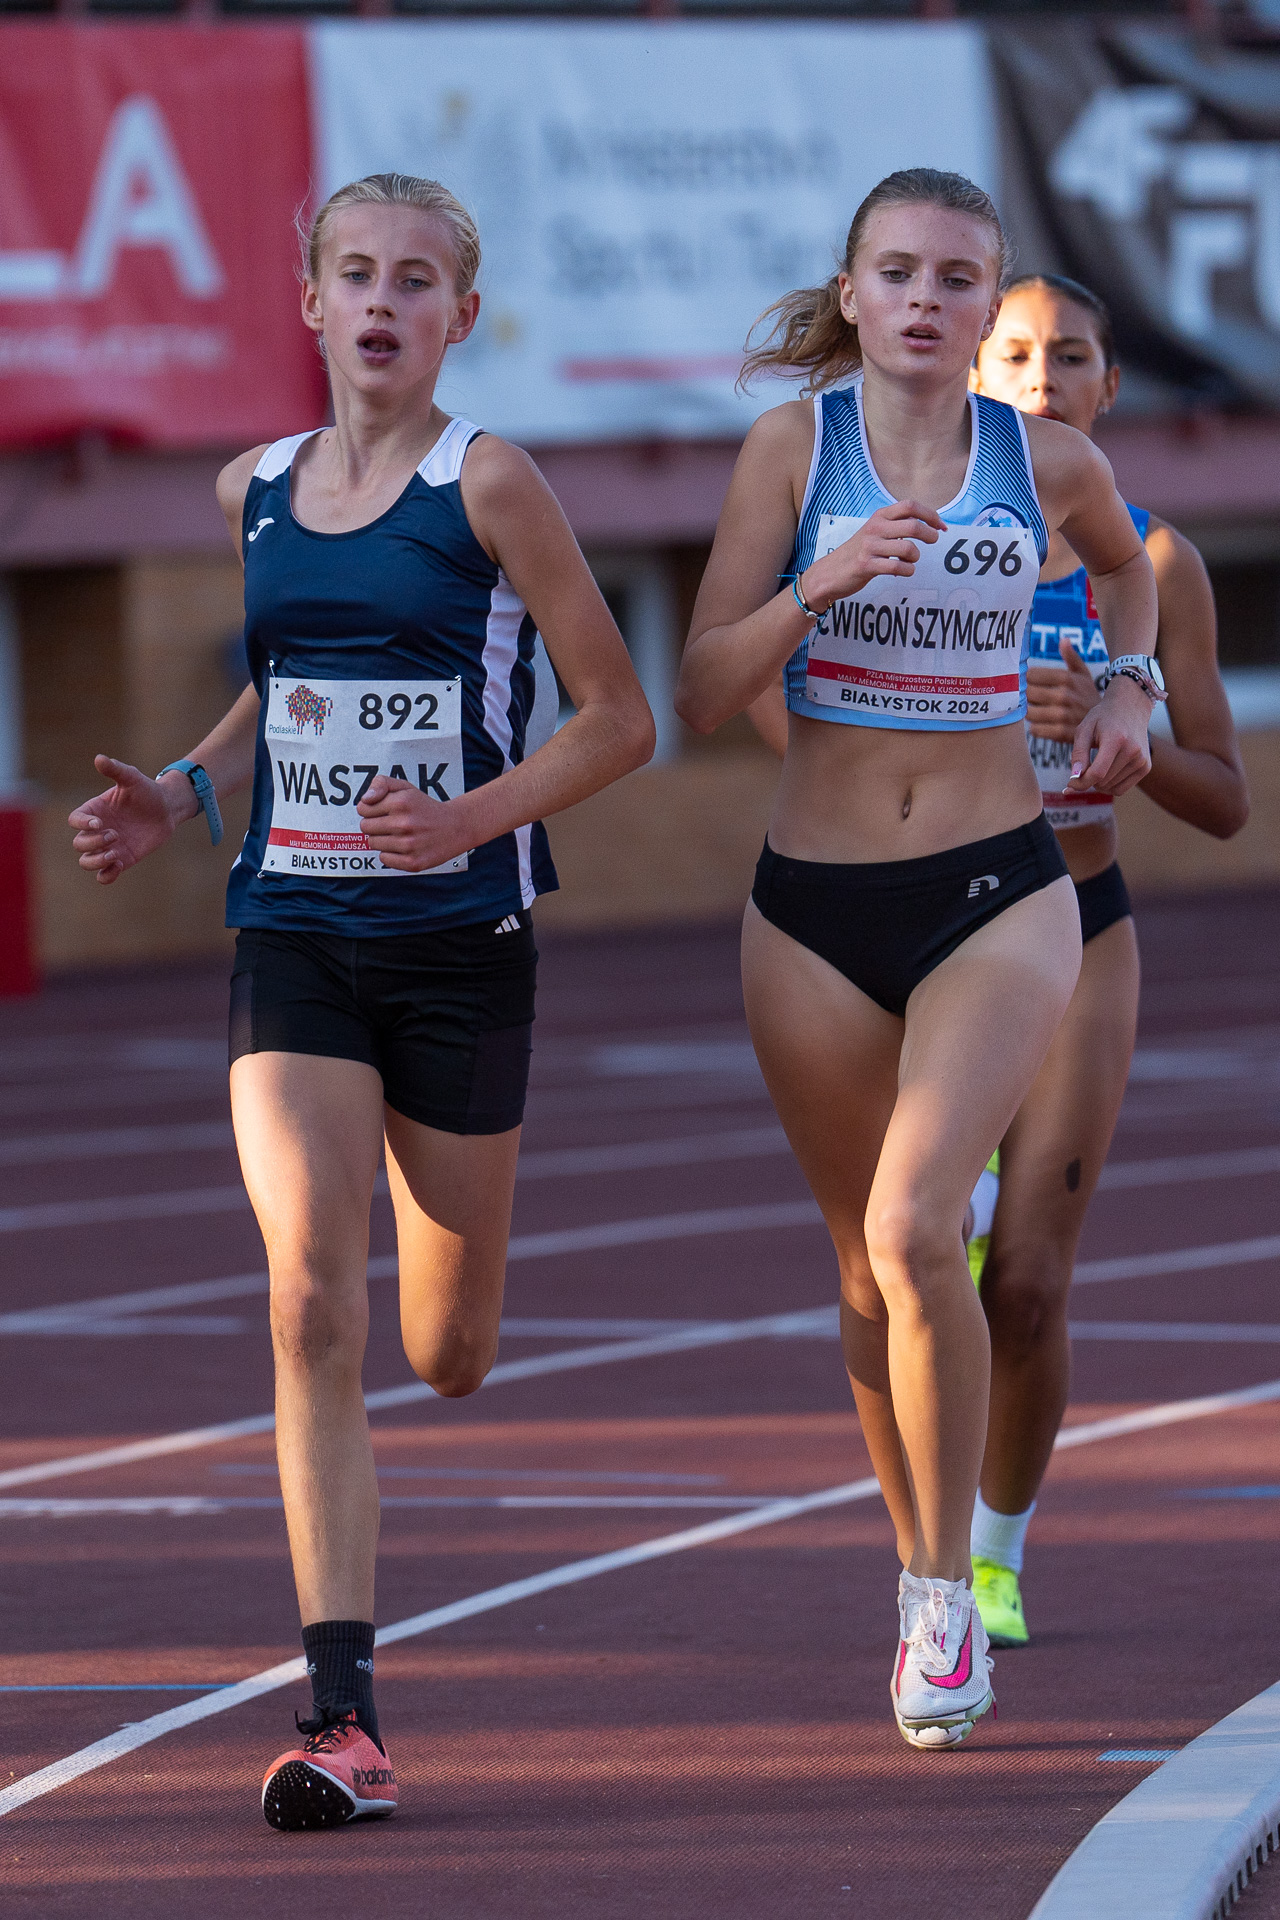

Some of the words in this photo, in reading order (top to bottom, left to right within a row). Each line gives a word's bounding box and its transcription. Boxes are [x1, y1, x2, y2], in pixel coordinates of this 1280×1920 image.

[944, 538, 1022, 577] 696
[912, 607, 1023, 652] SZYMCZAK
[837, 673, 857, 683] MAŁY
[858, 678, 898, 691] MEMORIAŁ
[900, 683, 936, 693] JANUSZA
[937, 686, 996, 695] KUSOCIŃSKIEGO
[866, 670, 884, 680] PZLA
[886, 674, 933, 684] Mistrzostwa
[934, 677, 957, 686] Polski
[959, 678, 973, 686] U16
[841, 688, 943, 714] BIAŁYSTOK
[947, 700, 989, 714] 2024
[358, 693, 439, 731] 892
[268, 724, 297, 735] Podlaskie
[301, 841, 331, 849] MEMORIAŁ
[333, 842, 367, 850] JANUSZA
[304, 832, 318, 840] PZLA
[291, 854, 376, 870] BIAŁYSTOK
